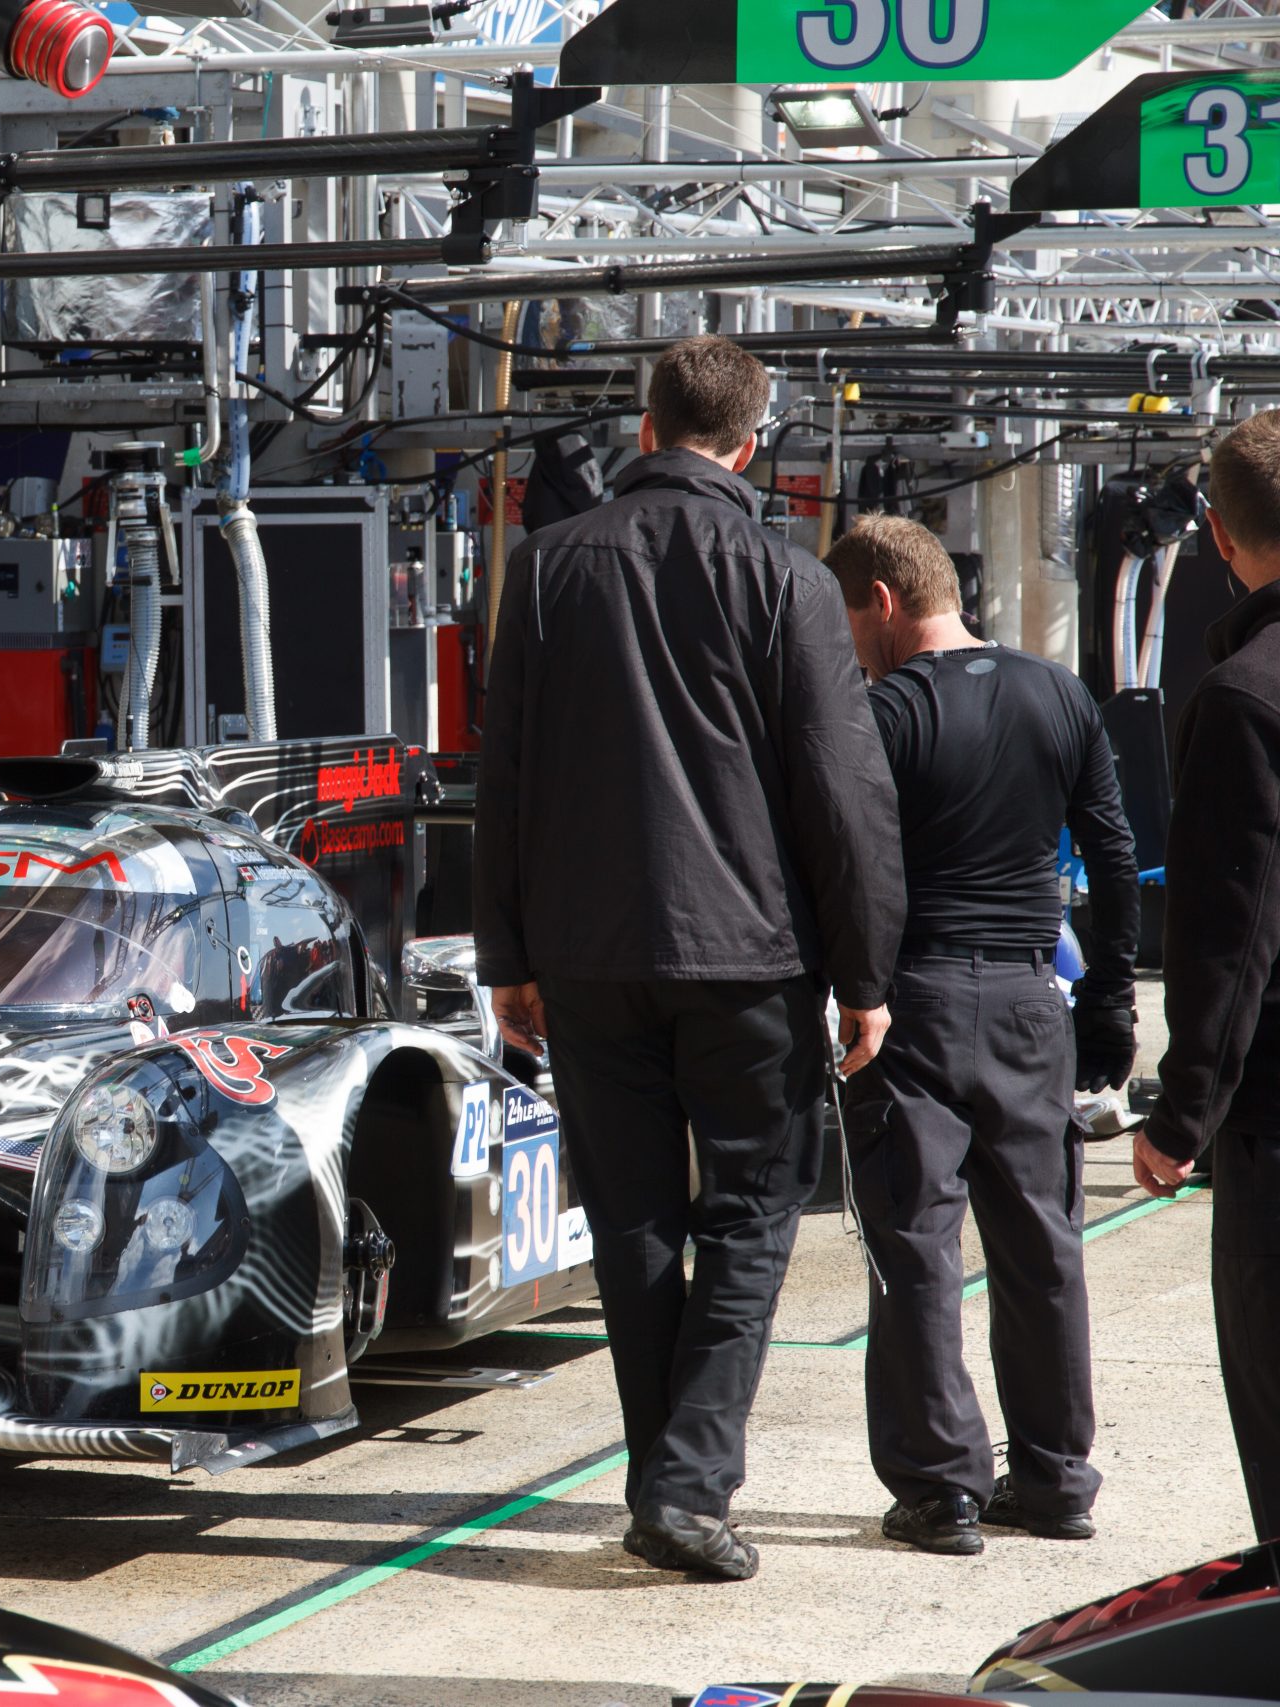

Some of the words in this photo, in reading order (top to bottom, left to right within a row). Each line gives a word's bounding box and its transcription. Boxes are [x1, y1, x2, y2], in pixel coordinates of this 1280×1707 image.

[321, 819, 405, 856] Basecamp.com
[523, 1103, 534, 1122] LE
[460, 1099, 486, 1164] P2
[507, 1143, 556, 1272] 30
[176, 1380, 295, 1400] DUNLOP
